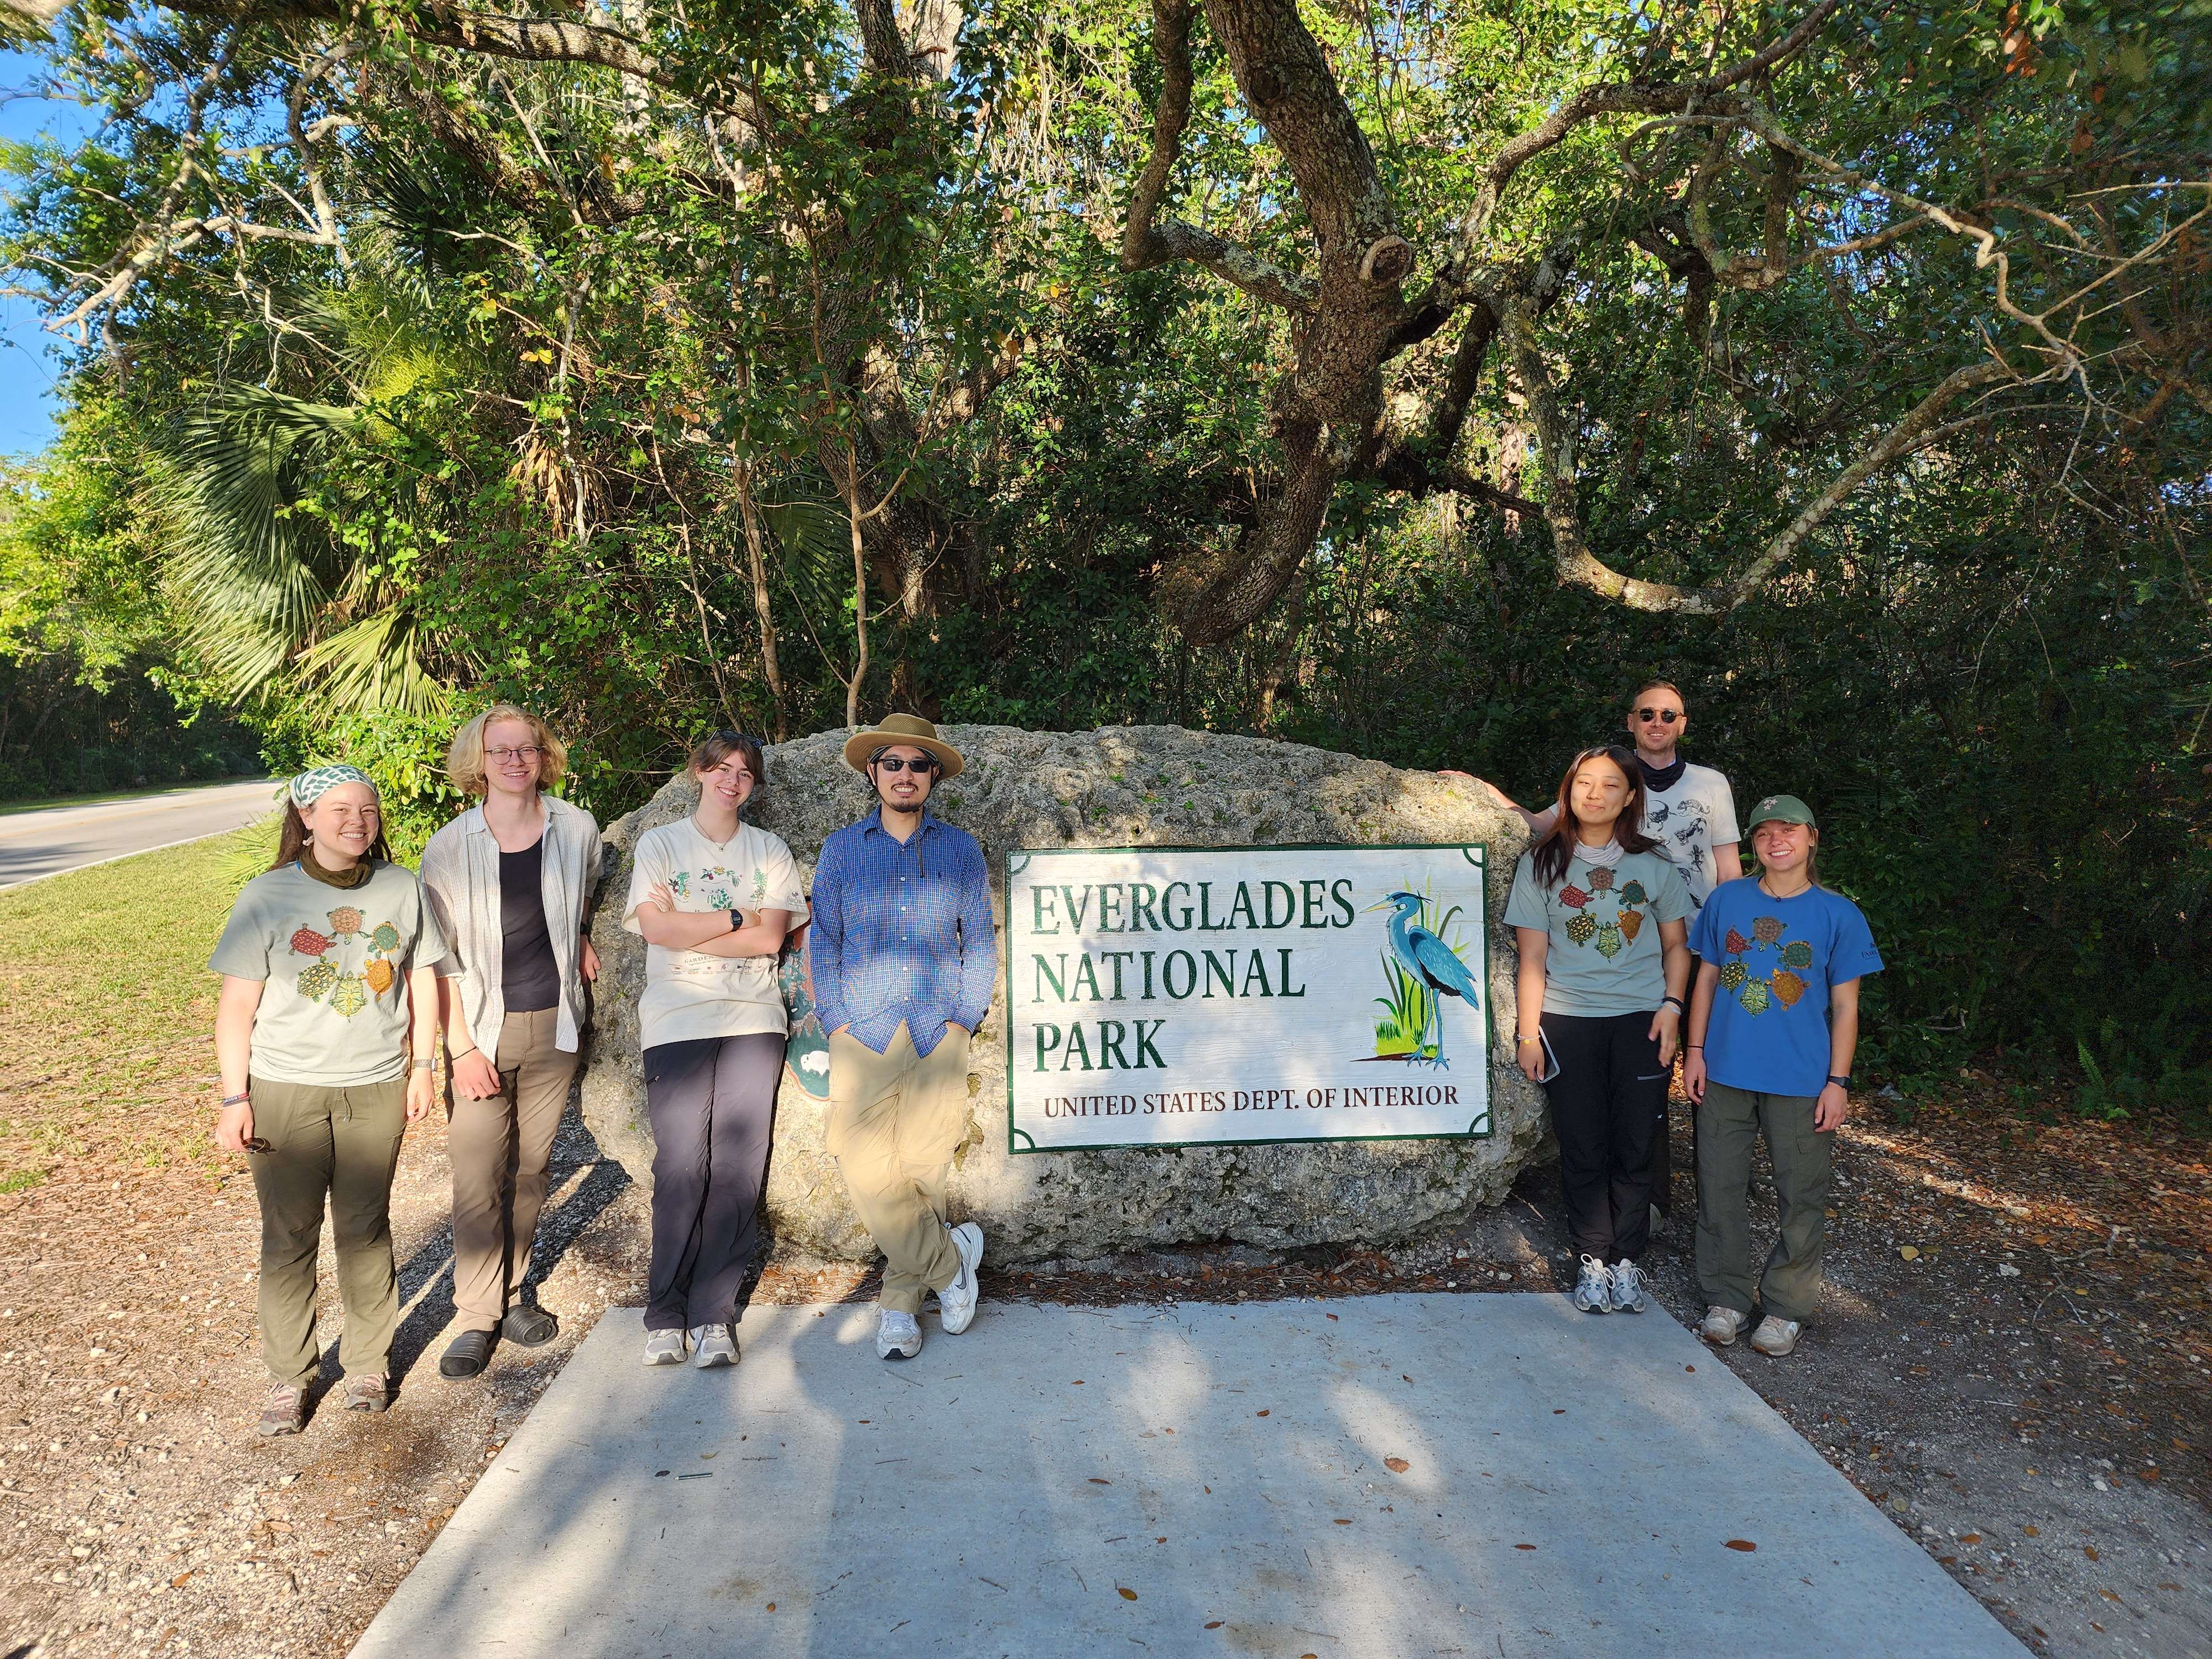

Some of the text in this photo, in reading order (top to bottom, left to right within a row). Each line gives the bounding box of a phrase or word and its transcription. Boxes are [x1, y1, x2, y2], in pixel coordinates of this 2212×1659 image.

[1030, 879, 1355, 935] EVERGLADES
[1031, 948, 1306, 1003] NATIONAL
[1032, 1019, 1167, 1072] PARK
[1045, 1085, 1459, 1118] UNITED STATES DEPT. OF INTERIOR
